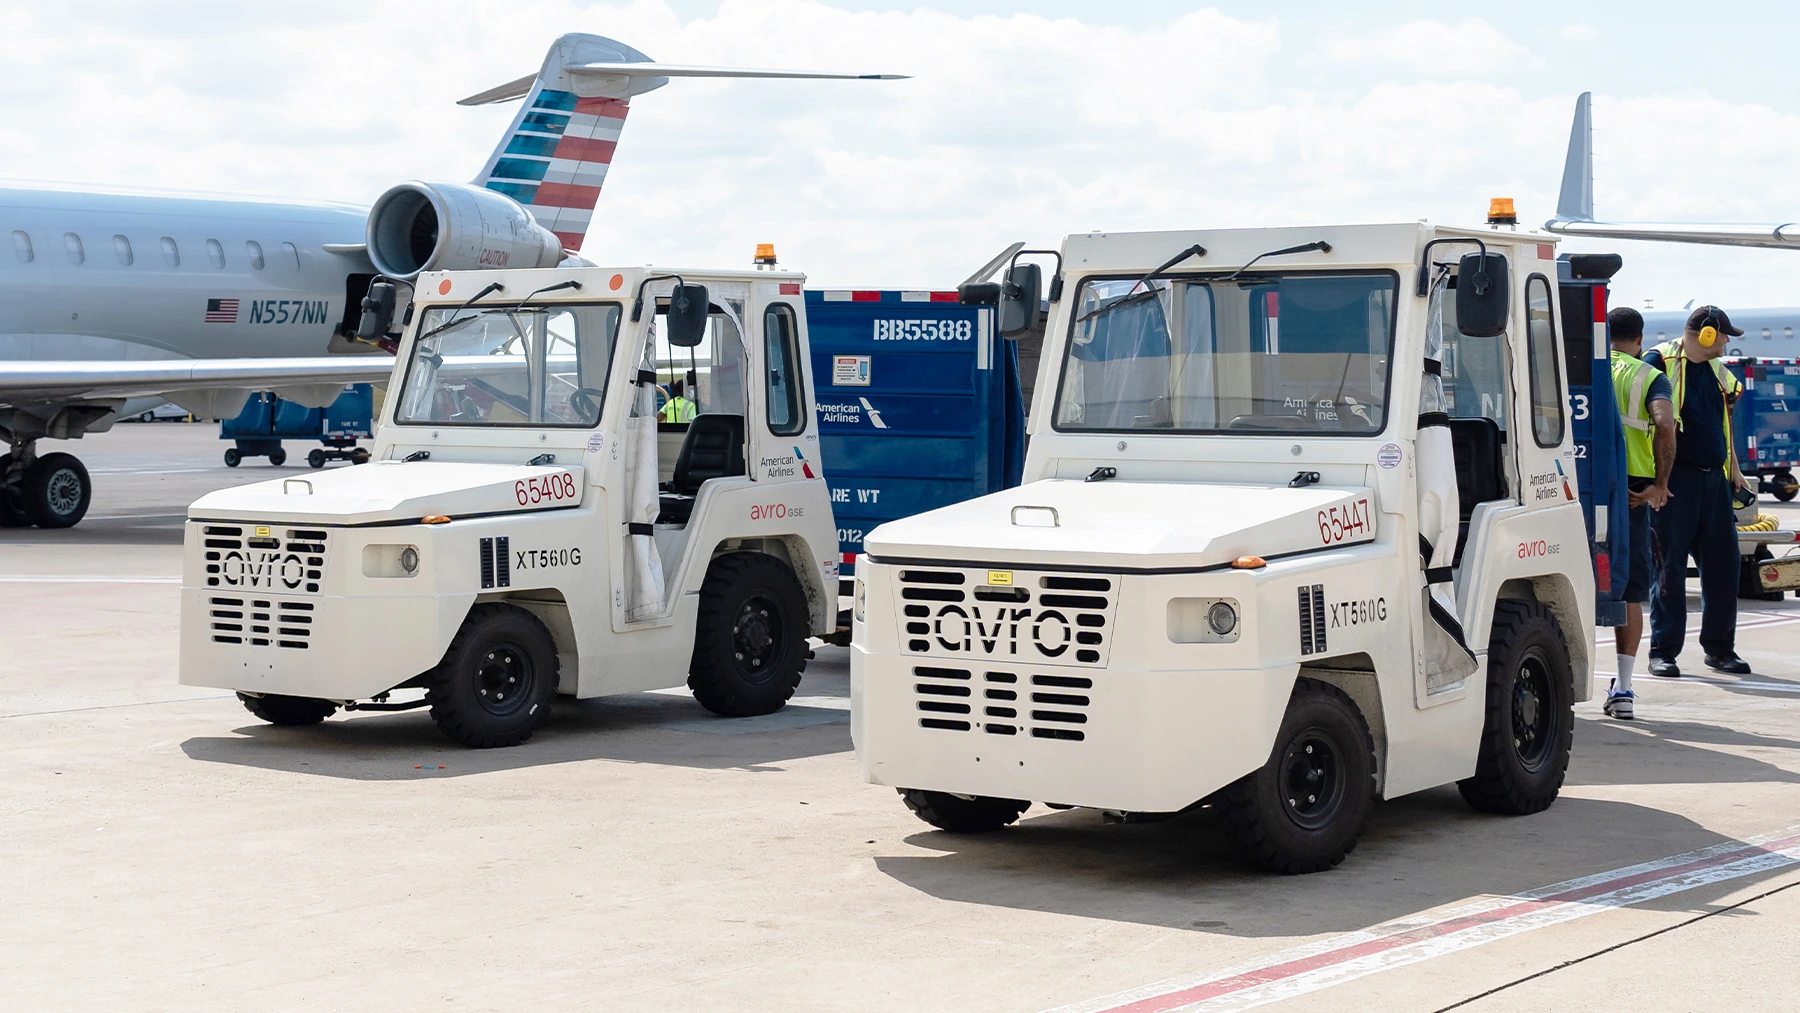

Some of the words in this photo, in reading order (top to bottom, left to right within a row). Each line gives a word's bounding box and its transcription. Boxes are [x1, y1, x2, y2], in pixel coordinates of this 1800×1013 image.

[480, 248, 510, 267] CAUTION
[249, 299, 328, 324] N557NN
[873, 319, 972, 341] BB5588
[815, 403, 860, 413] American
[823, 413, 860, 423] Airlines
[760, 455, 794, 467] American
[767, 467, 795, 478] Airlines
[1529, 471, 1557, 487] American
[514, 473, 576, 506] 65408
[829, 488, 851, 503] RE
[857, 489, 880, 503] WT
[1535, 486, 1558, 501] Airlines
[750, 503, 787, 521] avro
[787, 507, 804, 517] GSE
[1317, 498, 1371, 545] 65447
[516, 547, 582, 570] XT560G
[1517, 539, 1547, 559] avro
[1547, 543, 1560, 555] GSE
[223, 551, 304, 589] avro
[1330, 597, 1387, 629] XT560G
[934, 604, 1072, 658] avro
